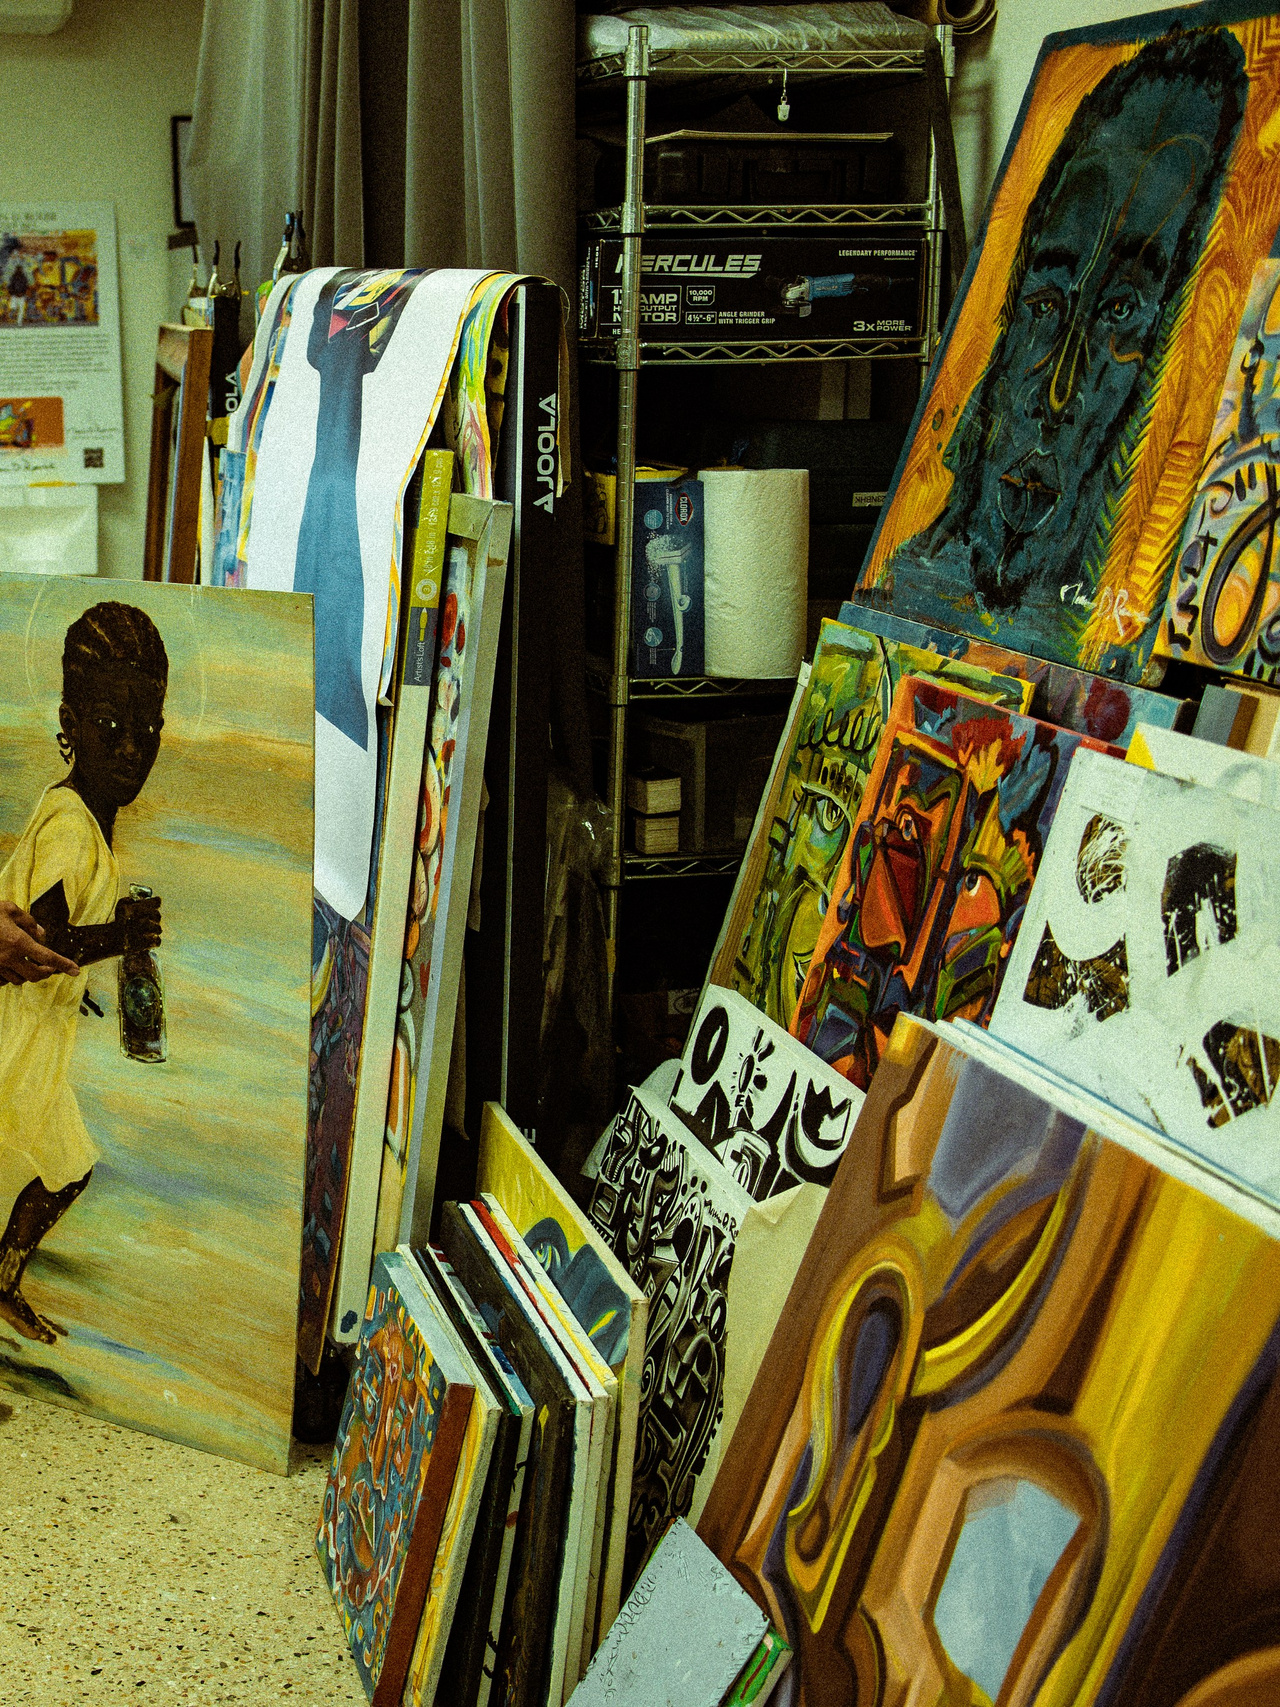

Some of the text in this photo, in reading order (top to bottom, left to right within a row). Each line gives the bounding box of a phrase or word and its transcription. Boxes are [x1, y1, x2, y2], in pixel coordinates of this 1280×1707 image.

[838, 249, 916, 257] LEGENDARY PERFORMANCE
[640, 293, 678, 305] AMP
[612, 312, 677, 322] MTOR
[225, 371, 240, 416] OLA
[680, 496, 688, 522] CLOROX
[417, 641, 426, 657] Loft
